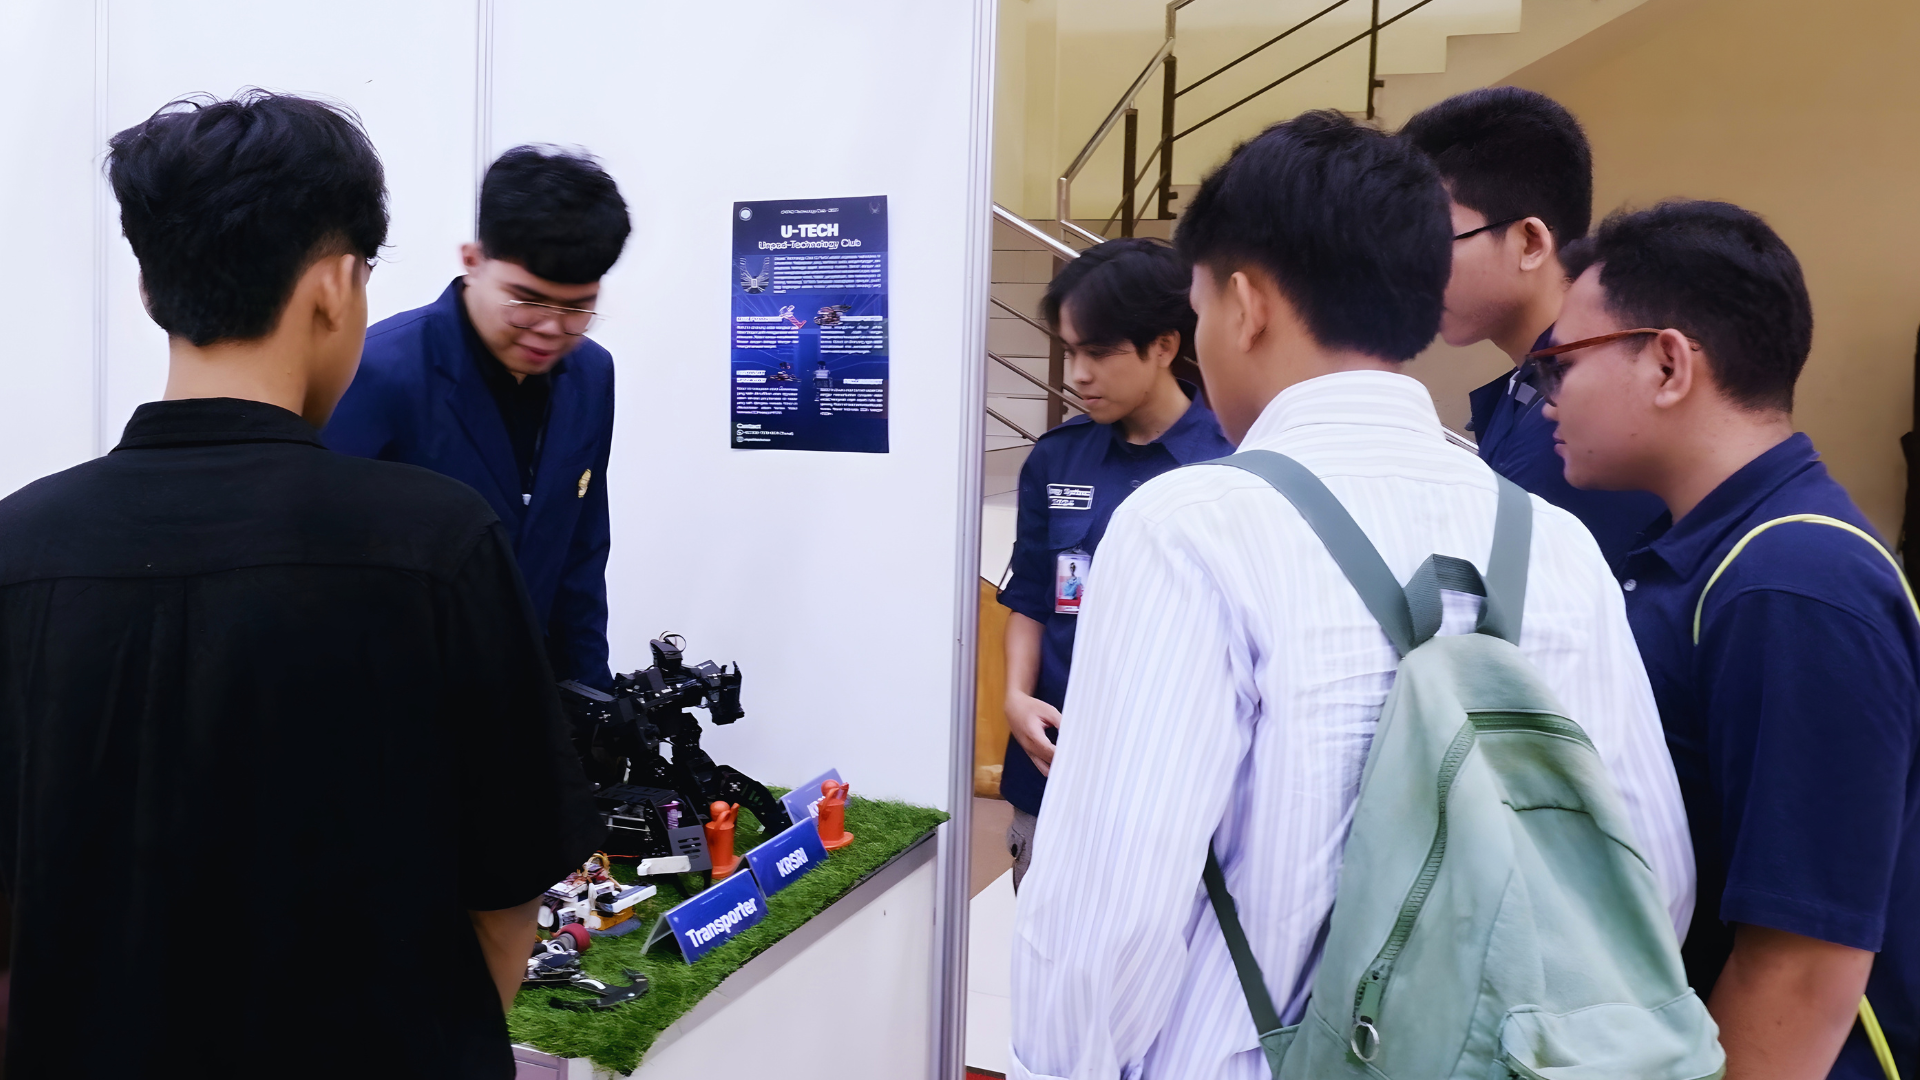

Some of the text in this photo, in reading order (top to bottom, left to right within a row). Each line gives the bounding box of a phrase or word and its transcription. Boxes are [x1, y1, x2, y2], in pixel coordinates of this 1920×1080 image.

[780, 223, 839, 239] U-TECH
[840, 238, 862, 248] Club
[775, 847, 809, 877] KRSRI
[685, 897, 758, 947] Transporter
